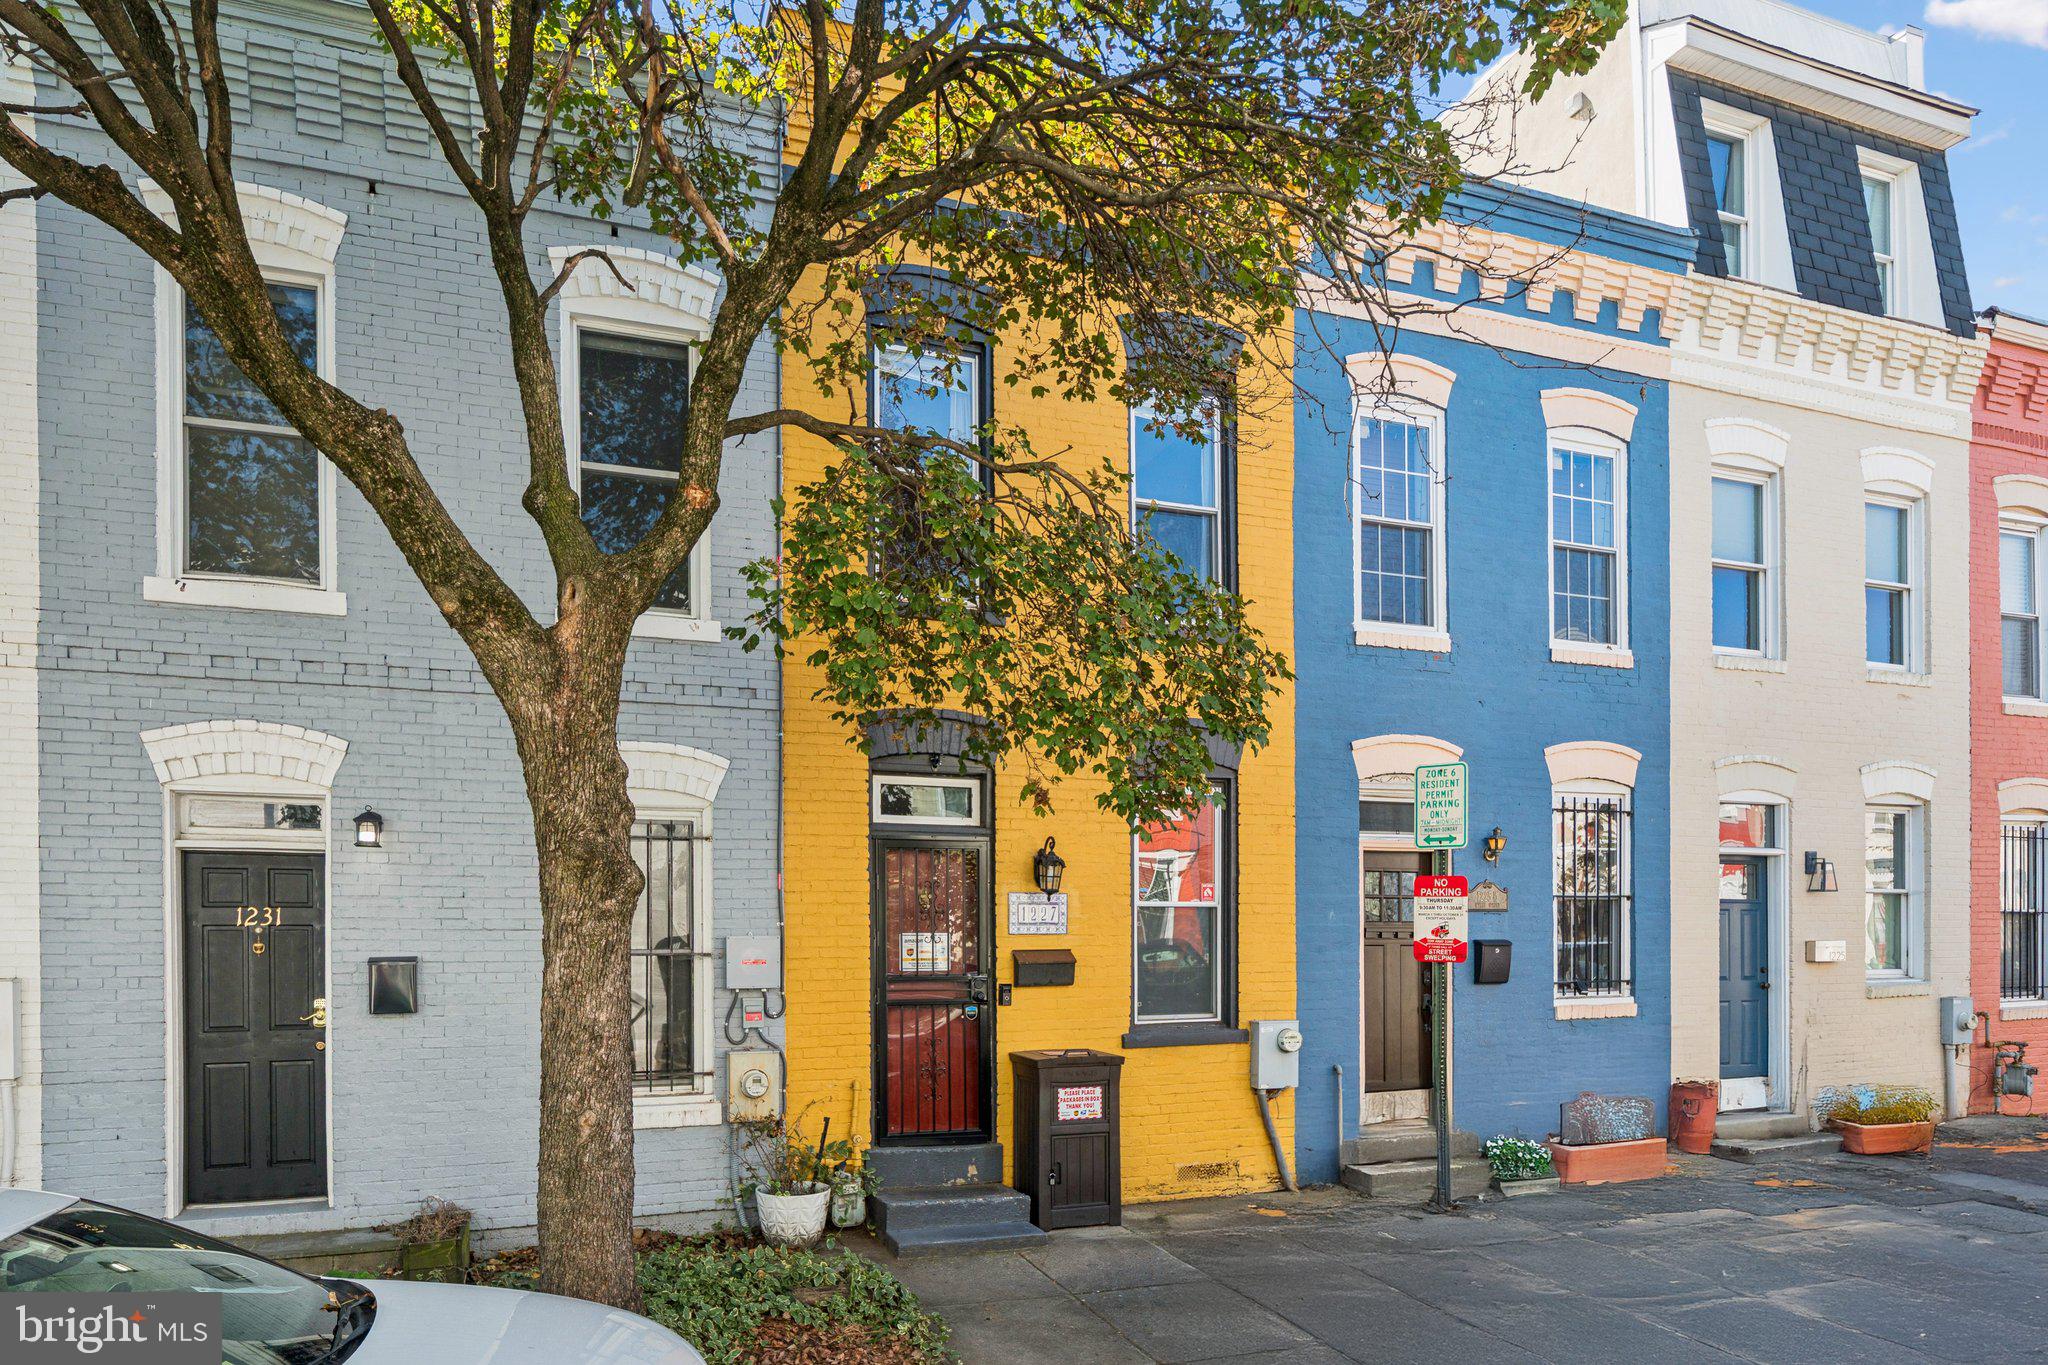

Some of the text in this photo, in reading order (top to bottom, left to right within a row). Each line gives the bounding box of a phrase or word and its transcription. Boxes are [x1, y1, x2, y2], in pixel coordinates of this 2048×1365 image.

[1425, 768, 1456, 778] ZONE 6
[1420, 779, 1459, 789] RESIDENT
[1425, 790, 1454, 799] PERMIT
[1420, 799, 1460, 809] PARKING
[1429, 810, 1449, 819] ONLY
[1434, 878, 1448, 887] NO
[1420, 888, 1462, 896] PARKING
[236, 906, 281, 927] 1231
[1022, 906, 1057, 921] 1227
